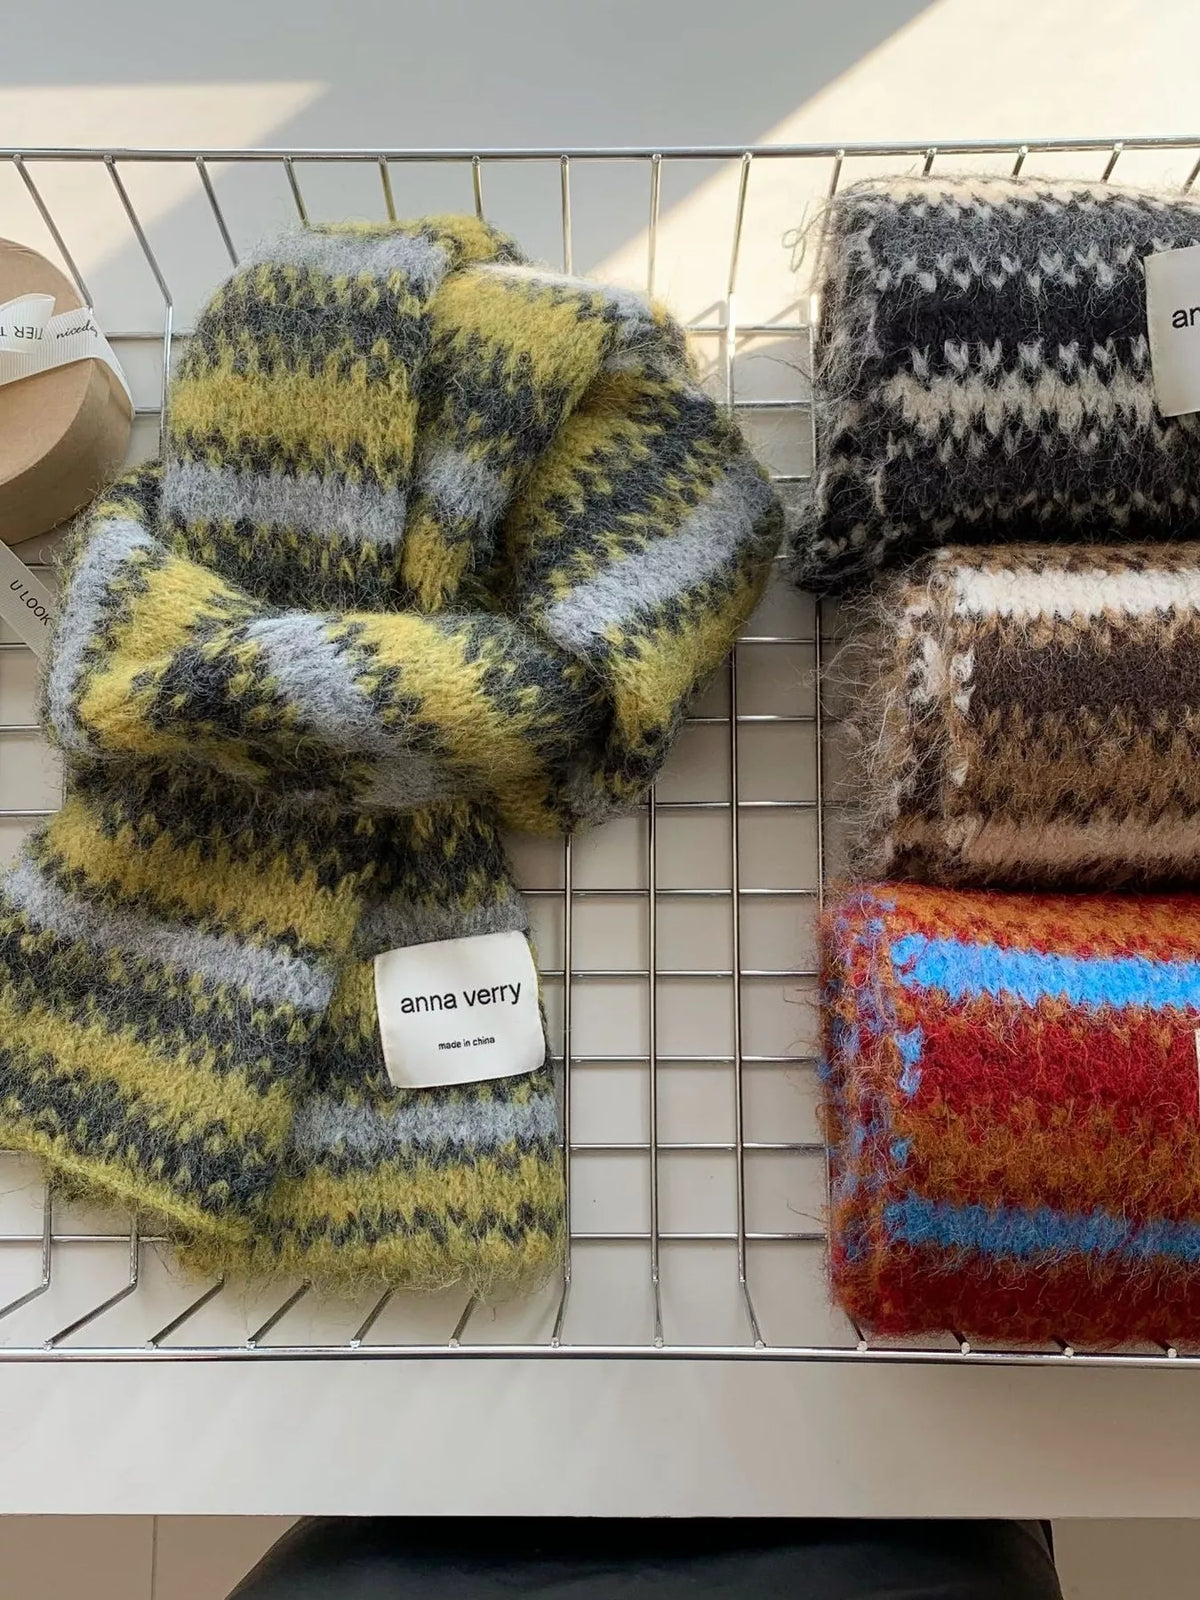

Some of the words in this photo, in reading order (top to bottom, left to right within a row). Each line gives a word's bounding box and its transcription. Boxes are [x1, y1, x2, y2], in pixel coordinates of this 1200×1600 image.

[9, 579, 23, 591] U
[19, 590, 52, 626] LOOK
[400, 993, 458, 1014] anna
[463, 982, 521, 1007] verry
[438, 1040, 462, 1050] made
[463, 1039, 471, 1047] in
[472, 1036, 496, 1046] china
